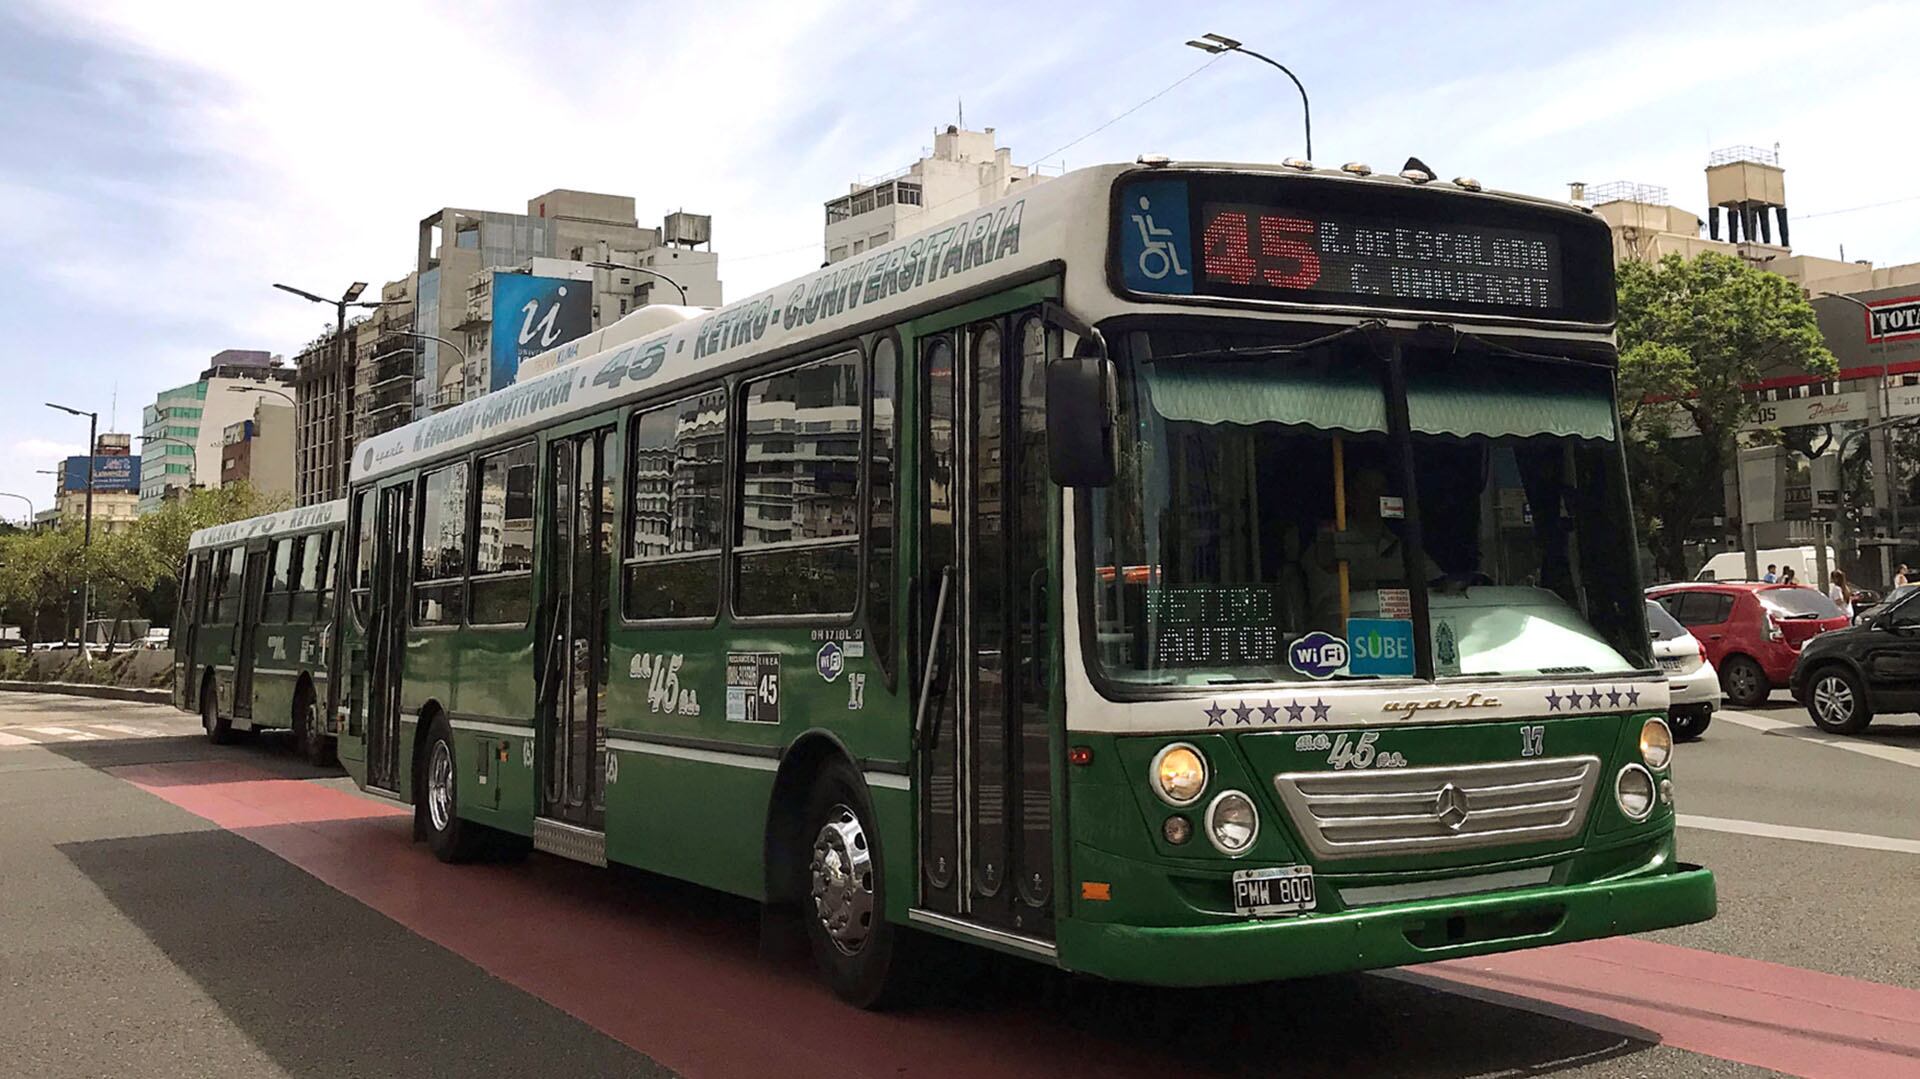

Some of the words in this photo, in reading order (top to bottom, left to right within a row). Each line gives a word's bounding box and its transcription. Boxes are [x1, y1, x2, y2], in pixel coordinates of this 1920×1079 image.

[1204, 212, 1320, 290] 45
[1351, 264, 1380, 296] C.
[1392, 266, 1550, 308] UNIVERSIT
[592, 333, 672, 389] 45
[694, 294, 774, 361] RETIRO
[290, 504, 333, 529] RETIRO
[1147, 587, 1272, 622] RETIRO
[758, 655, 779, 666] LINEA
[1296, 647, 1342, 664] WiFi
[1354, 635, 1409, 660] SUBE
[648, 653, 683, 714] 45
[758, 674, 778, 705] 45
[848, 672, 865, 710] 17
[1381, 692, 1503, 721] ugarte
[1326, 732, 1381, 771] 45
[1520, 725, 1545, 757] 17
[1237, 880, 1271, 907] PMW
[1280, 877, 1312, 903] 800
